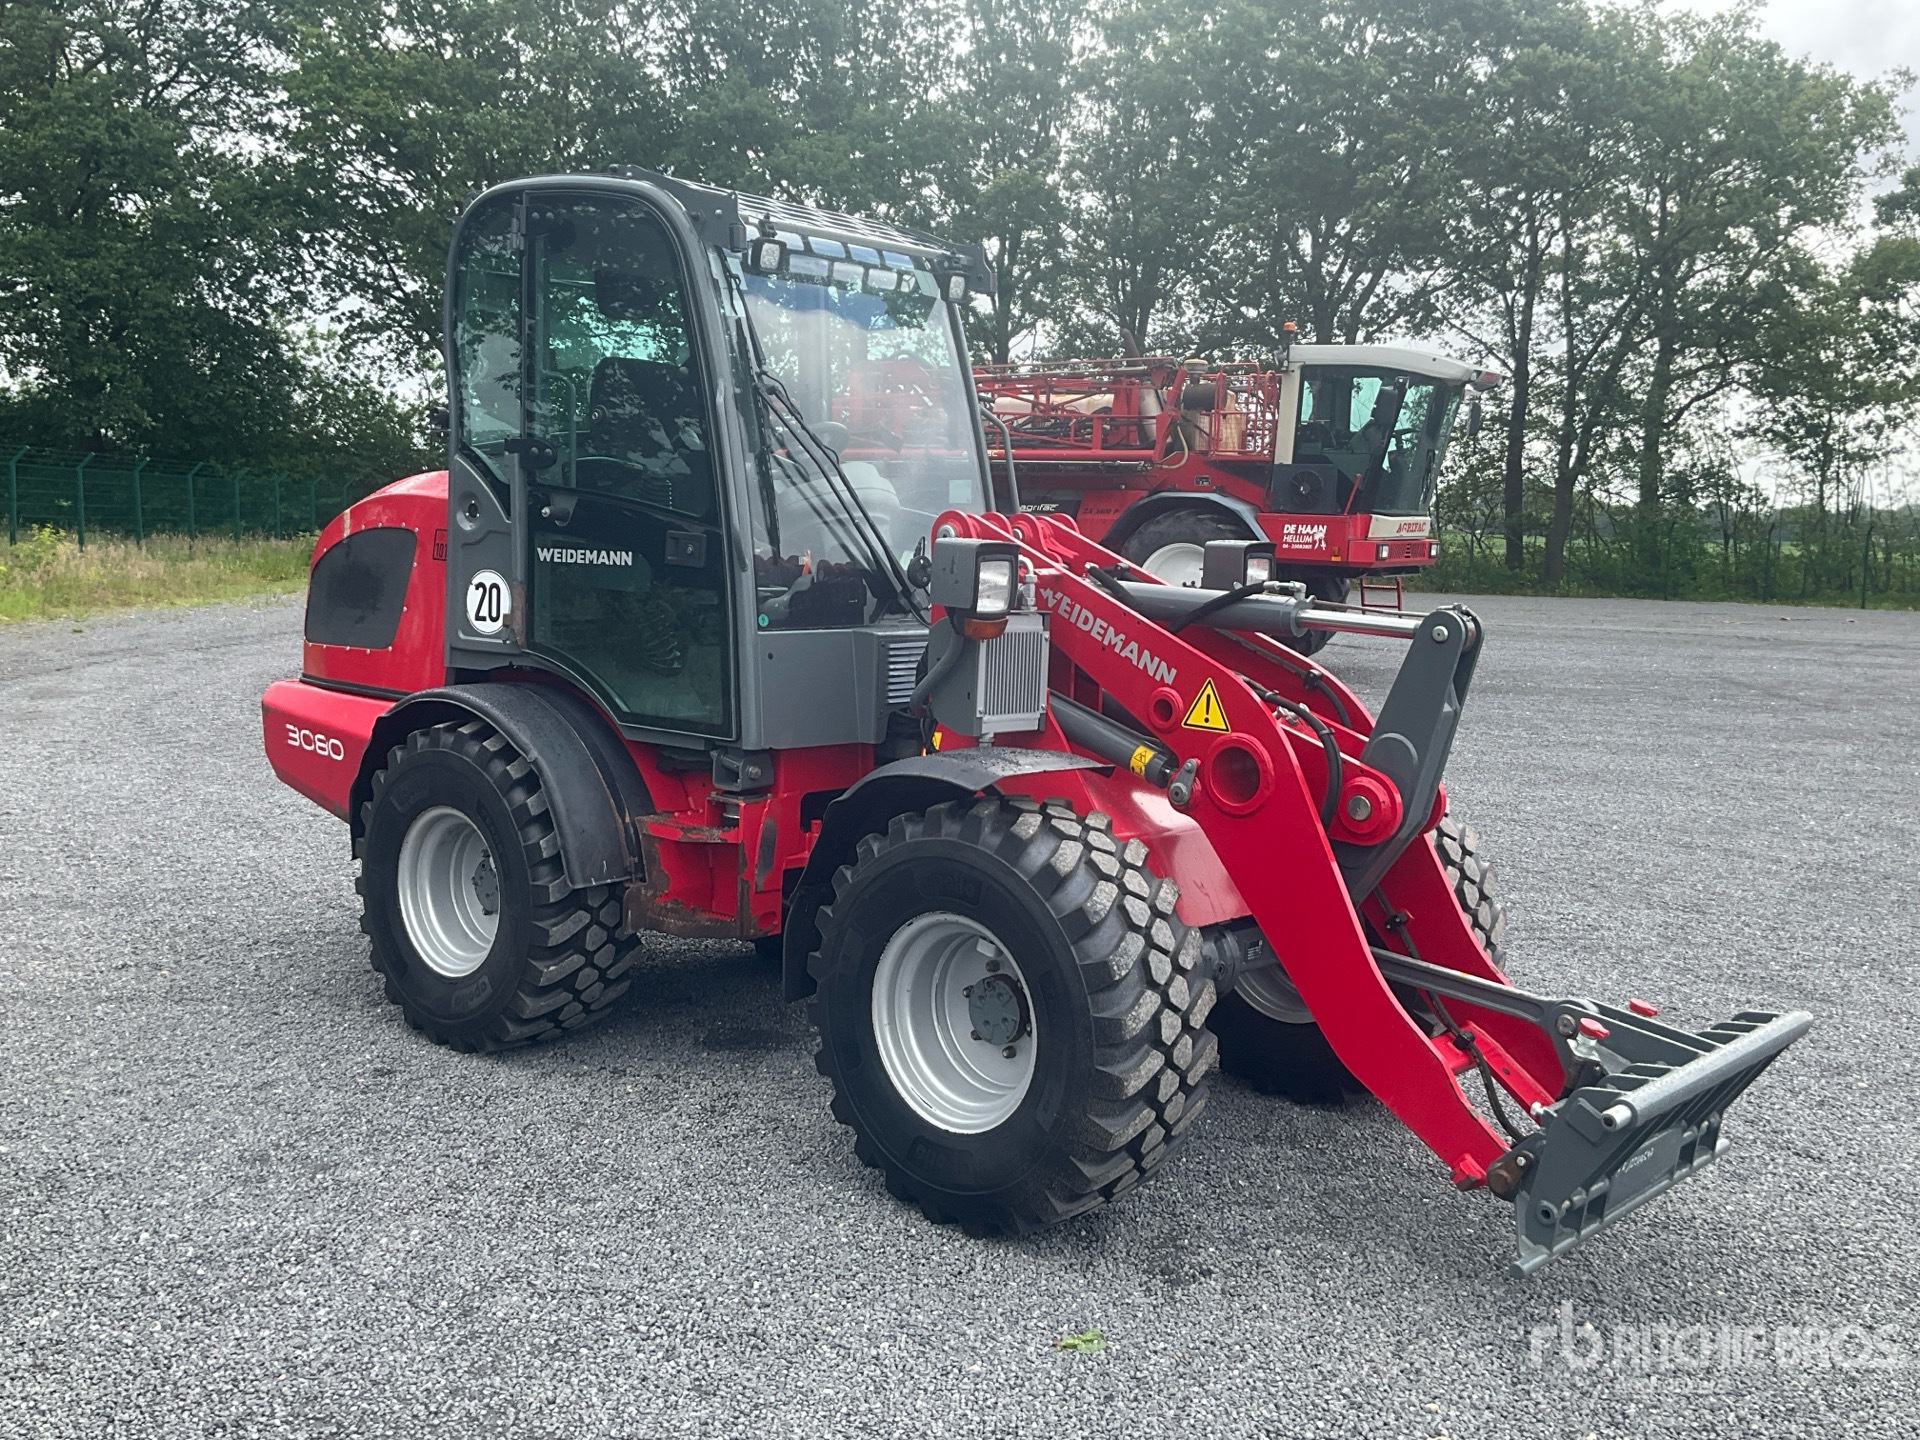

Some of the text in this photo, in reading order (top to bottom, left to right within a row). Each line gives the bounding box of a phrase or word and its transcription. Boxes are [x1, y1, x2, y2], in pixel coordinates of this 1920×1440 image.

[1020, 503, 1059, 512] agrifac
[1283, 524, 1327, 535] DE HAAN
[1396, 522, 1427, 533] AGRIFAC
[1283, 534, 1313, 543] HELLUM
[537, 547, 633, 566] WEIDEMANN
[474, 581, 501, 623] 20
[1039, 586, 1178, 686] WEIDEMANN
[286, 723, 345, 762] 3060
